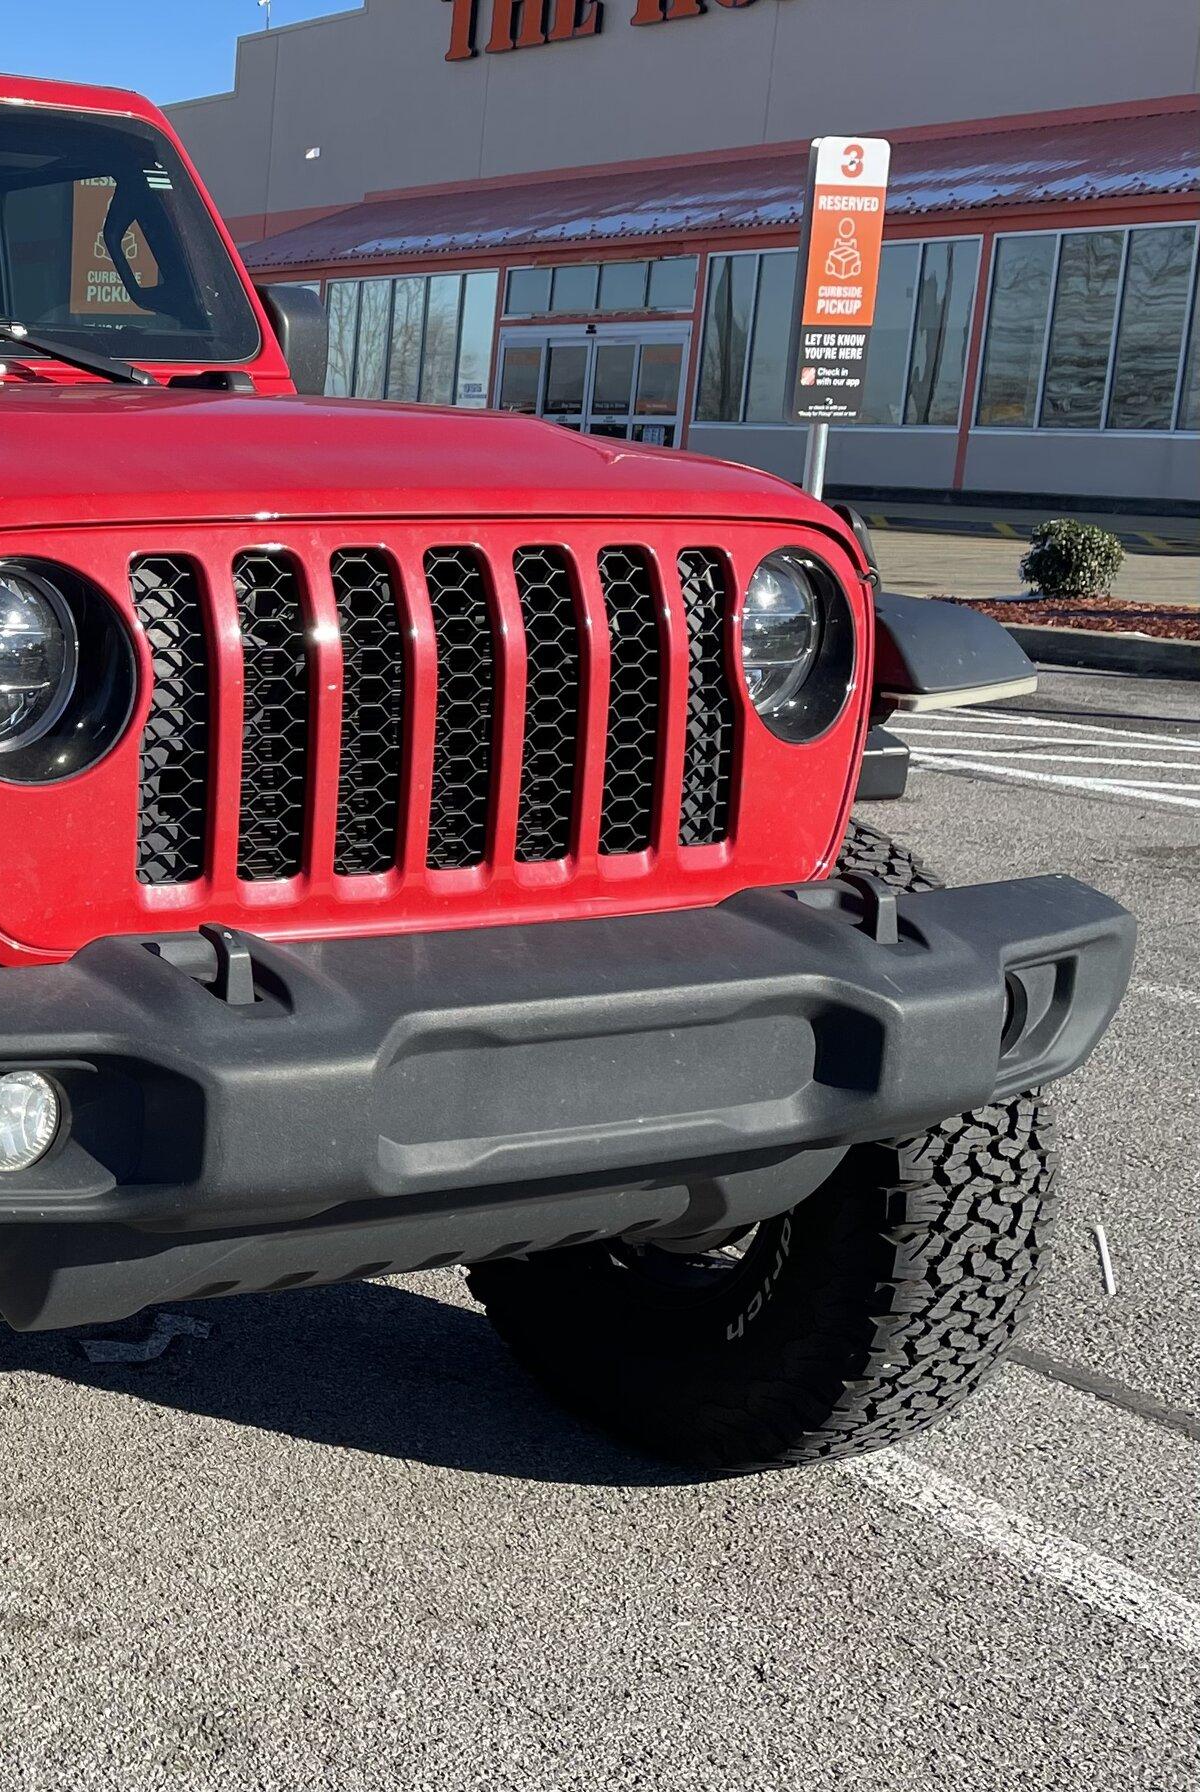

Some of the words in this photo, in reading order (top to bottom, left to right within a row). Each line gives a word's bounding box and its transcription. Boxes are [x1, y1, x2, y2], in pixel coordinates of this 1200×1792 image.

[841, 144, 864, 178] 3
[818, 195, 880, 212] RESERVED
[86, 285, 131, 302] PICKU
[818, 285, 863, 298] CURBSIDE
[816, 299, 862, 315] PICKUP
[805, 333, 822, 346] LET
[823, 333, 836, 346] US
[837, 334, 866, 346] KNOW
[805, 347, 838, 360] YOU'RE
[838, 347, 863, 360] HERE
[817, 367, 840, 376] Check
[841, 367, 849, 376] in
[816, 377, 832, 386] with
[832, 378, 845, 386] our
[845, 378, 860, 387] app
[726, 1206, 796, 1341] drich
